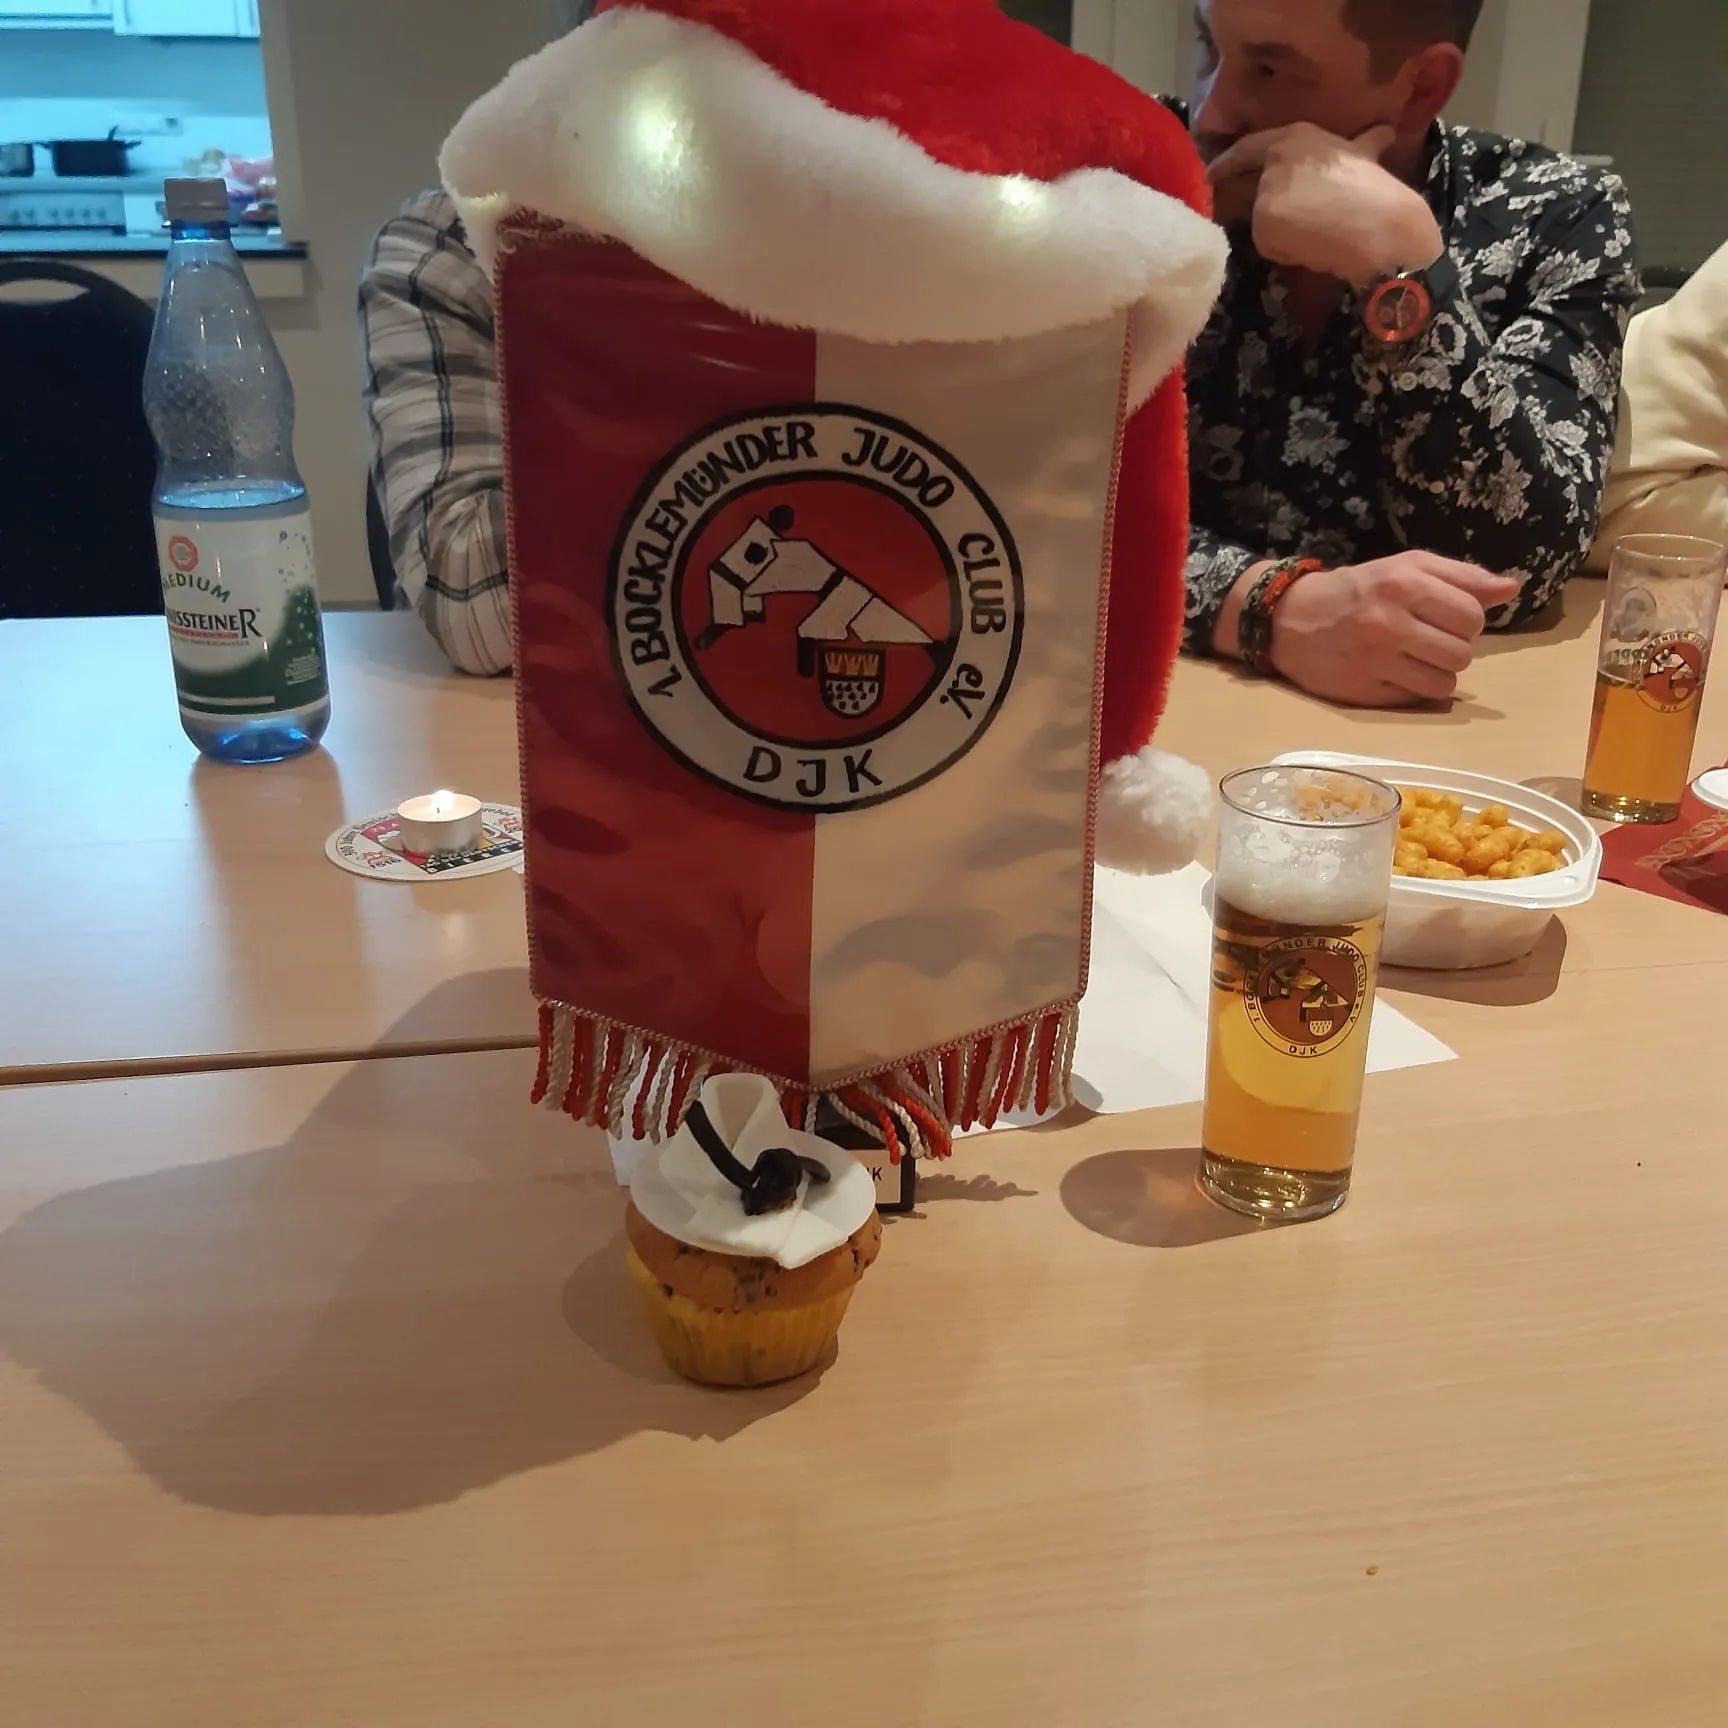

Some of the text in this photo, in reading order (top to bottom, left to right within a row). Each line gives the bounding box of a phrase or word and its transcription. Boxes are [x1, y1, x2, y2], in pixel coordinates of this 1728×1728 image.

[624, 421, 819, 667] BOCKLEMÜNDER
[841, 427, 955, 508] JUDO
[958, 532, 1007, 636] CLUB
[743, 746, 882, 798] DJK
[1289, 1044, 1318, 1056] DJK
